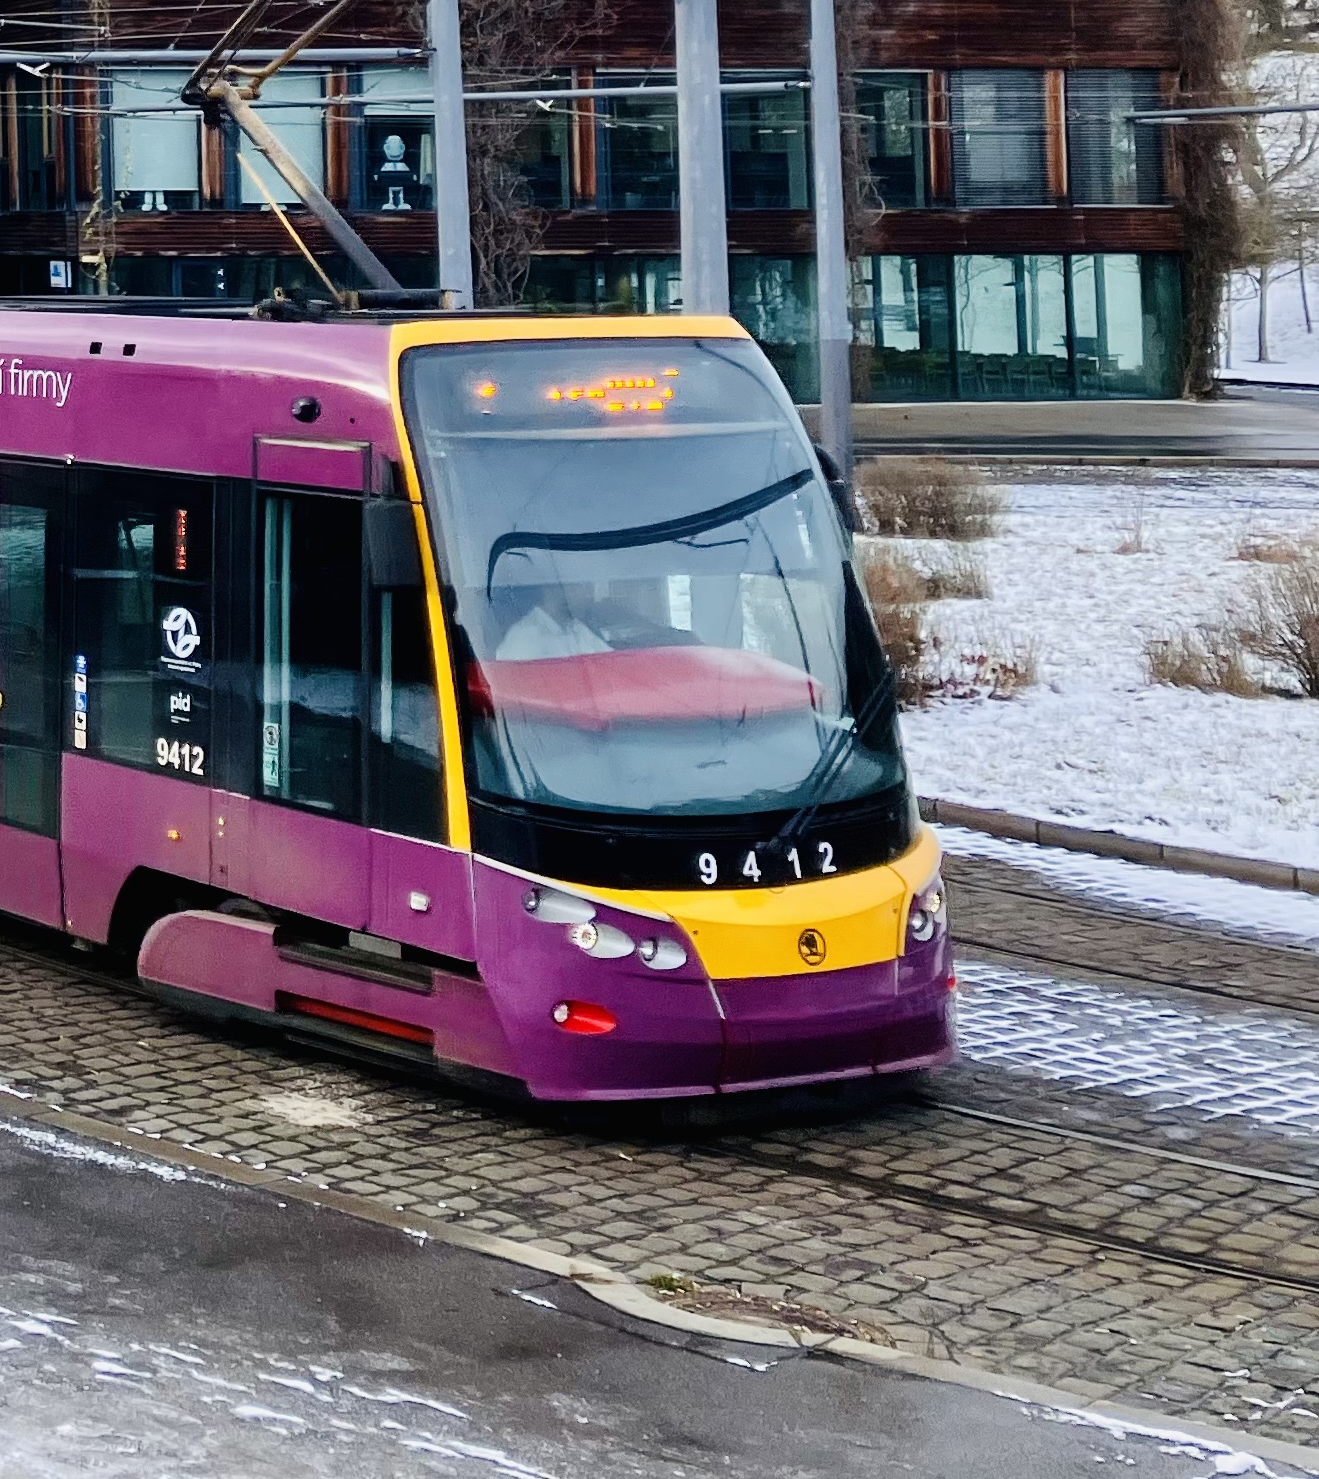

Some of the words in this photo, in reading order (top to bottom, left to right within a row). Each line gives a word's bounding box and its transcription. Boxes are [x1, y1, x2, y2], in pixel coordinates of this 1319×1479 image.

[8, 358, 73, 407] firmy
[170, 691, 191, 713] pid
[156, 737, 205, 776] 9412
[698, 841, 838, 885] 9412
